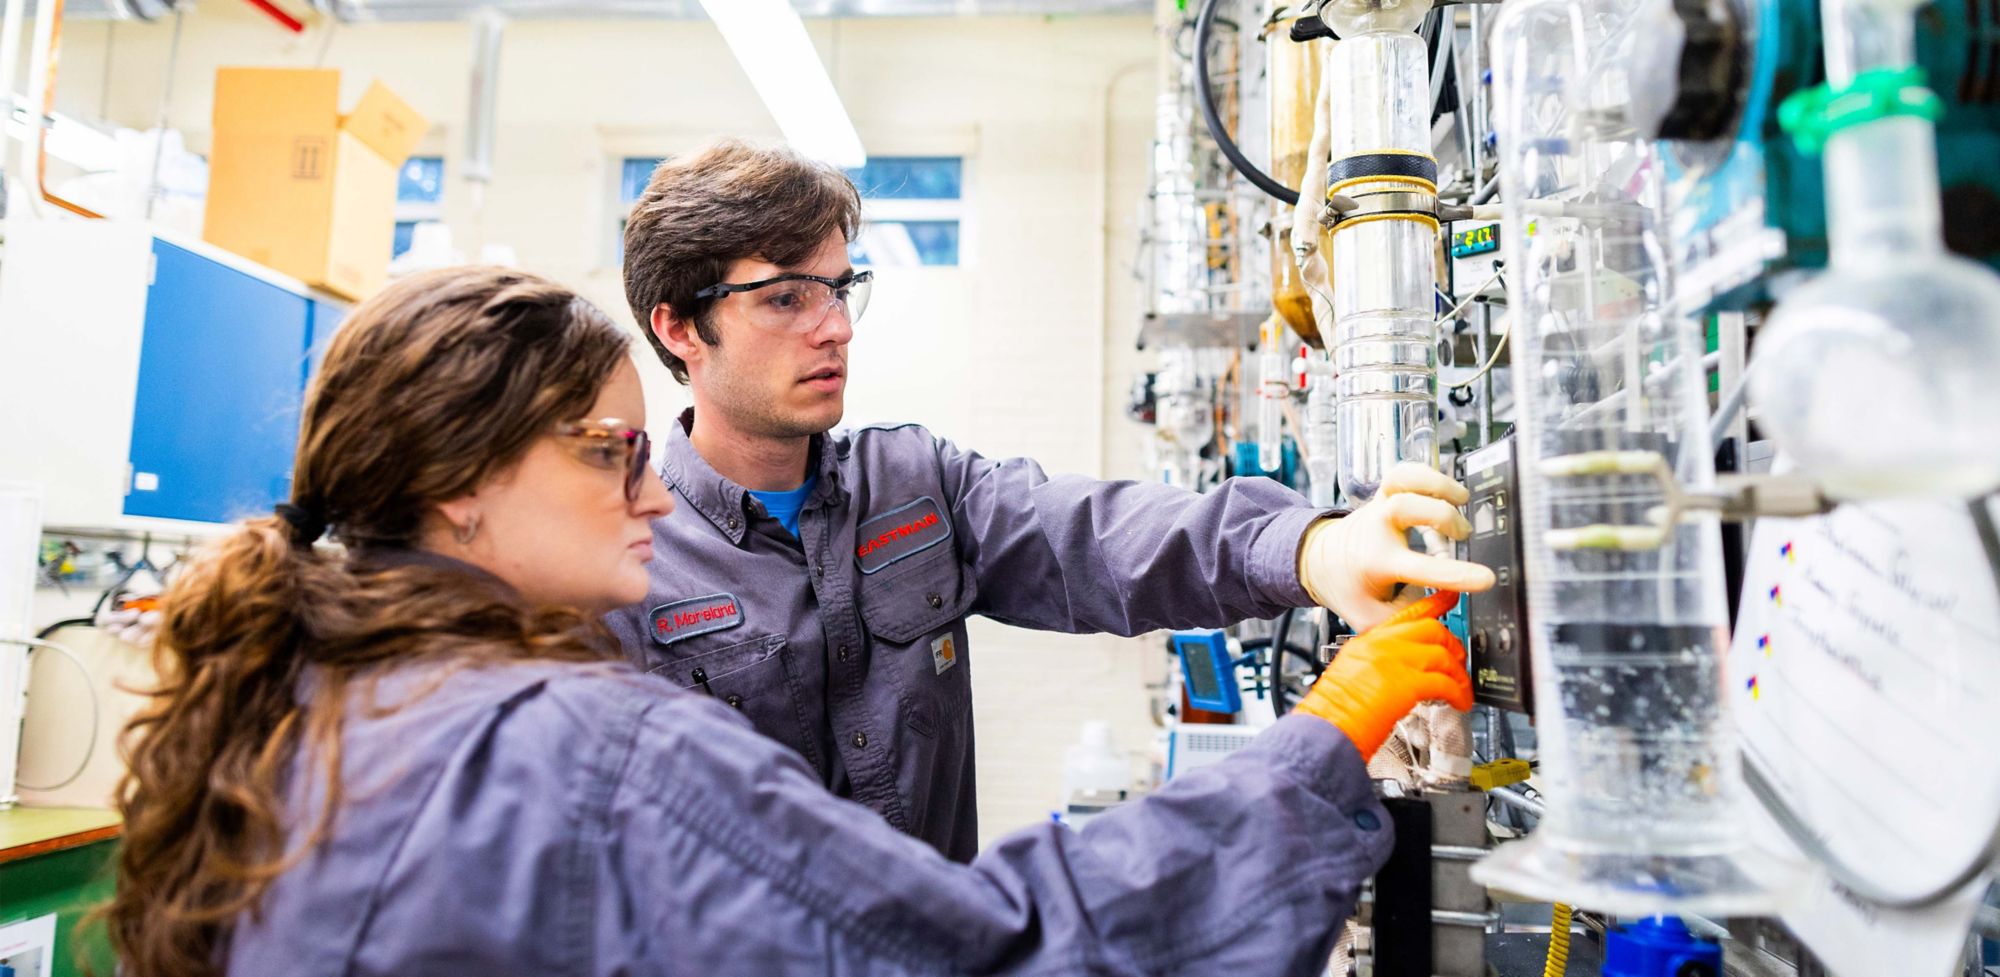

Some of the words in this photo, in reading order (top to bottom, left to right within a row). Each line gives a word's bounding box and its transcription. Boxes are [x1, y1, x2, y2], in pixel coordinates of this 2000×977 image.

[857, 512, 939, 559] EASTMAN
[656, 617, 673, 634] R.
[673, 601, 737, 630] Moreland
